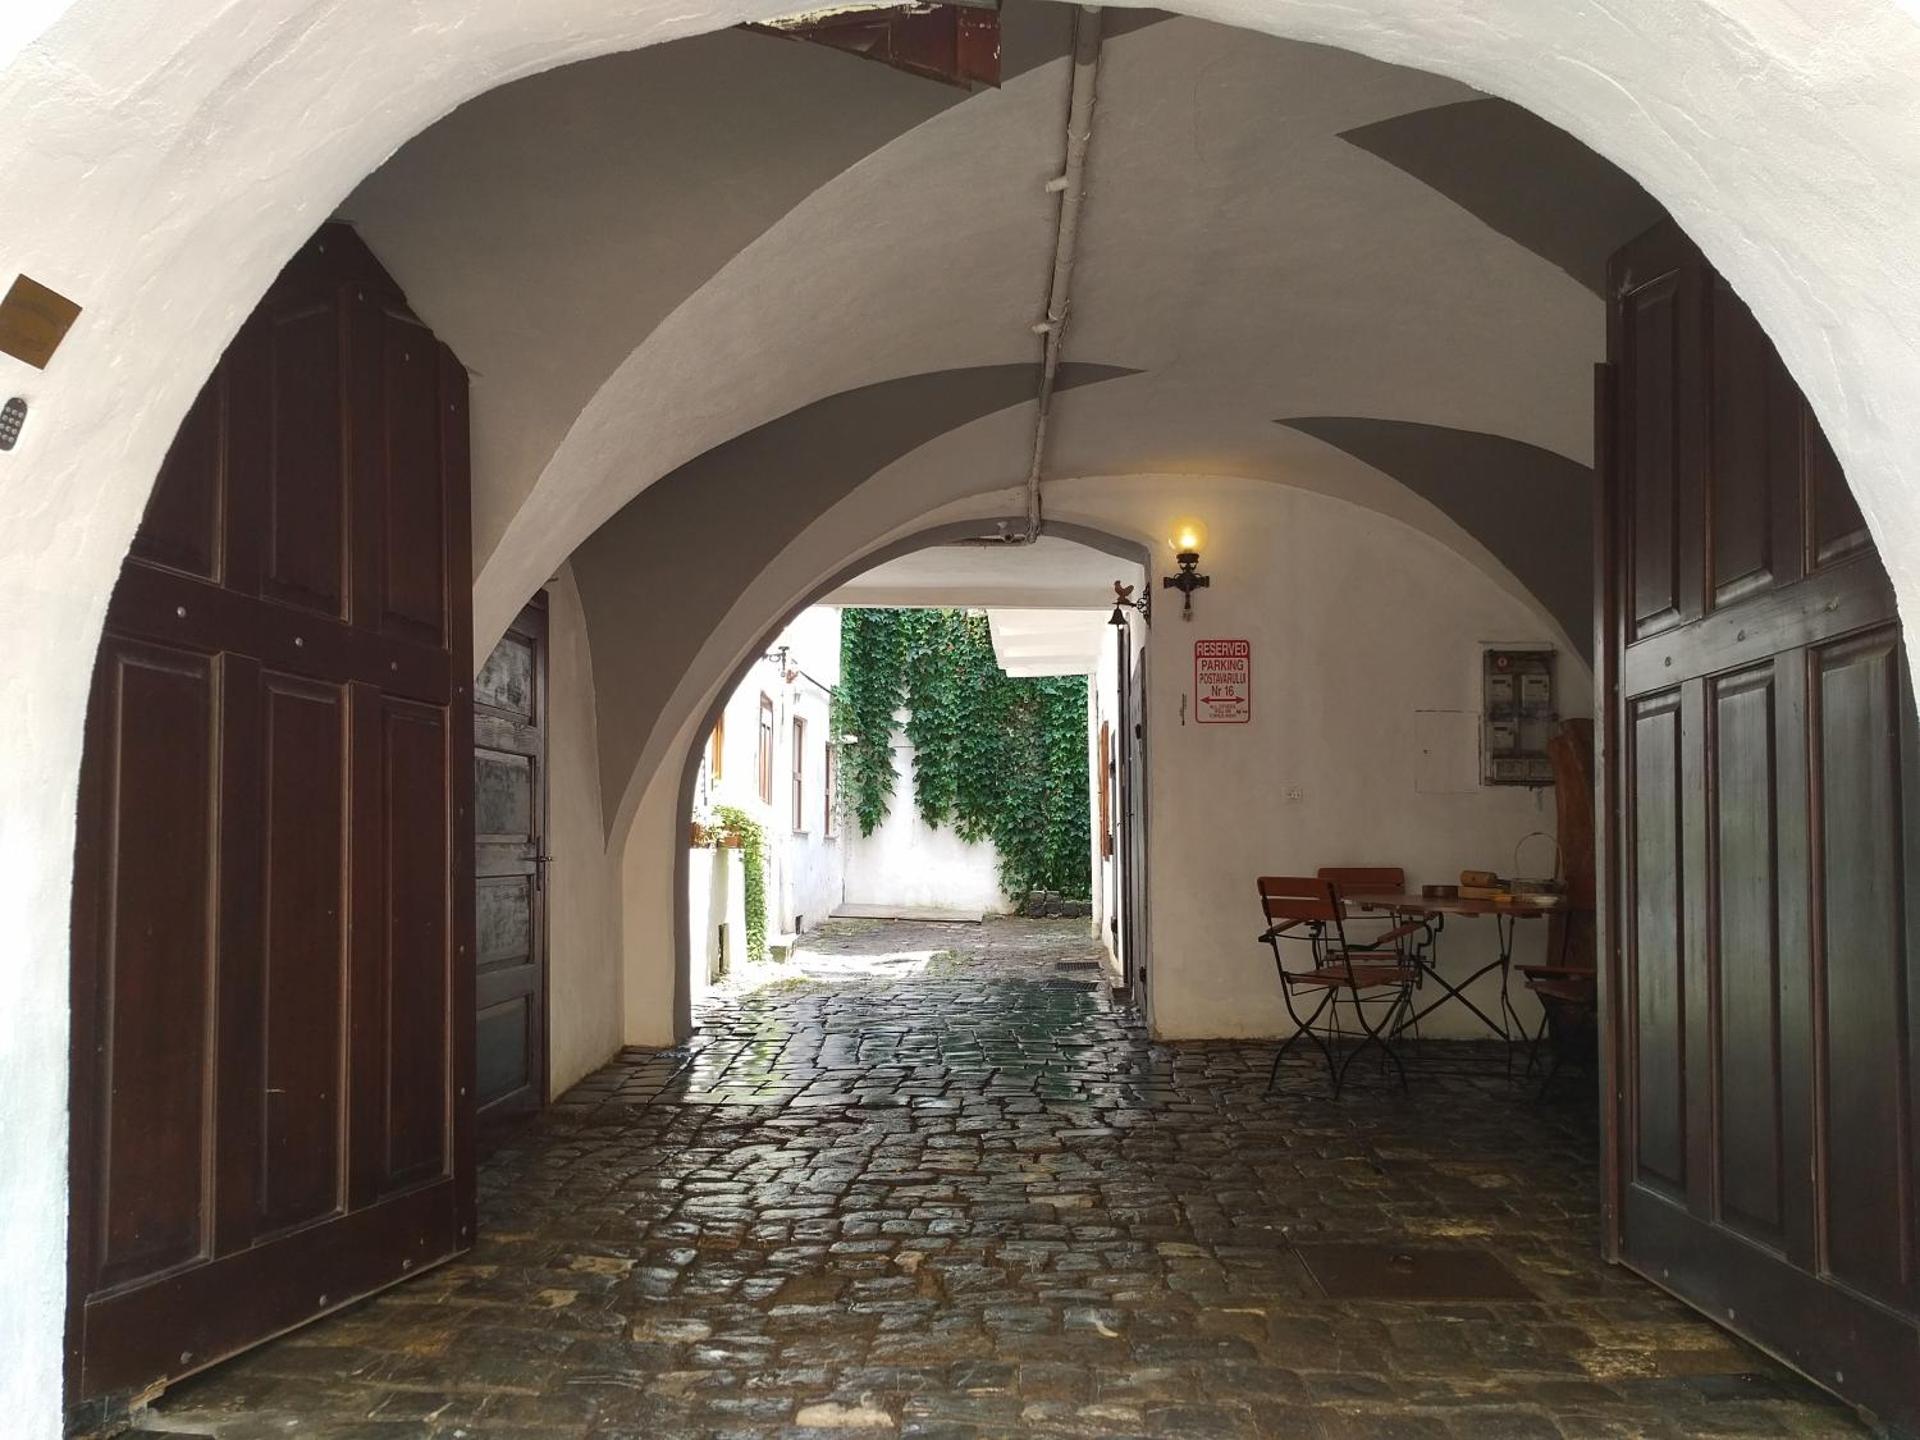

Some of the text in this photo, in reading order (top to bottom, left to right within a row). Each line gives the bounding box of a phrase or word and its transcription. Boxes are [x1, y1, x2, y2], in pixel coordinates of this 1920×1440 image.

[1196, 642, 1248, 656] RESERVED
[1201, 659, 1244, 671] PARKING
[1225, 685, 1235, 697] 16
